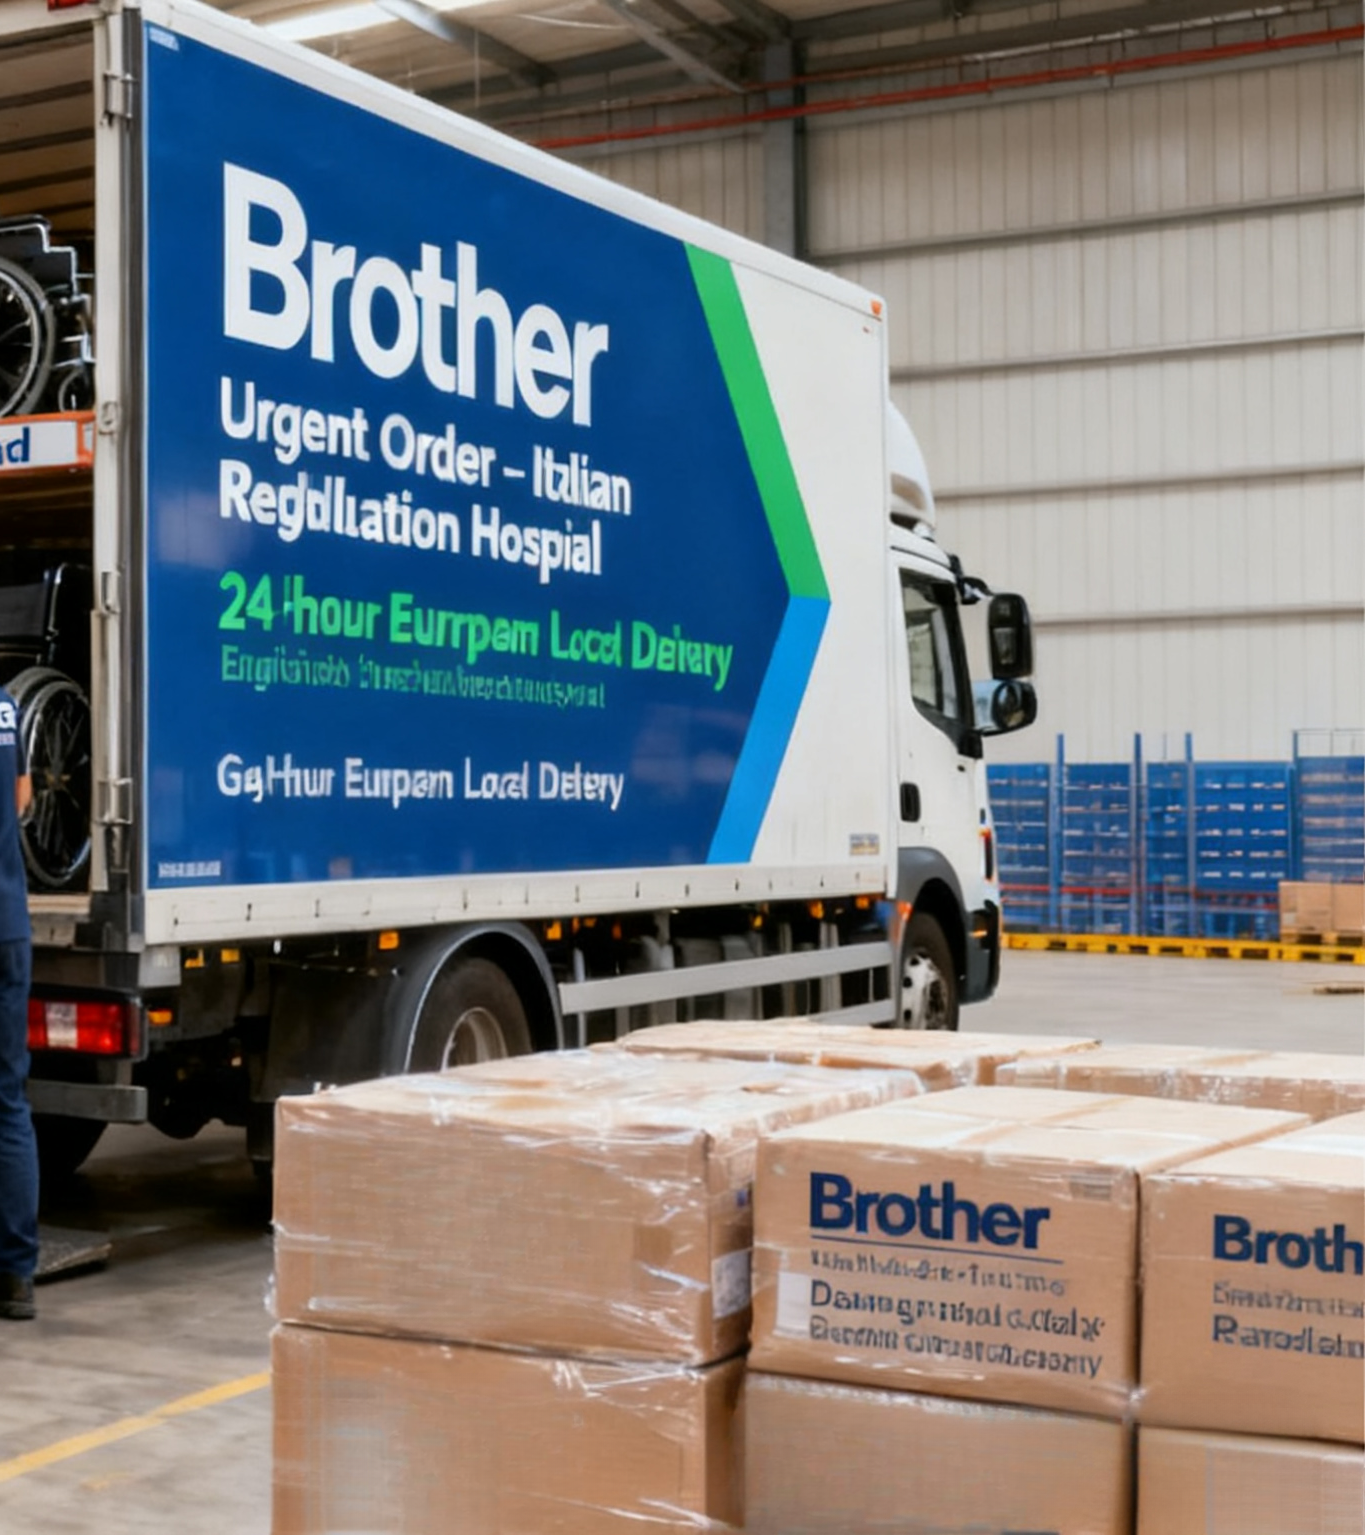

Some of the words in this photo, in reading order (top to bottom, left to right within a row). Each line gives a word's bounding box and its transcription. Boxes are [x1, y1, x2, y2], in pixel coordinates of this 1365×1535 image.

[223, 161, 609, 427] Brother
[220, 376, 370, 465] Urgent
[380, 413, 496, 487] Order
[472, 503, 602, 584] Hospial
[809, 1172, 1050, 1250] Brother
[1213, 1214, 1364, 1276] Broth
